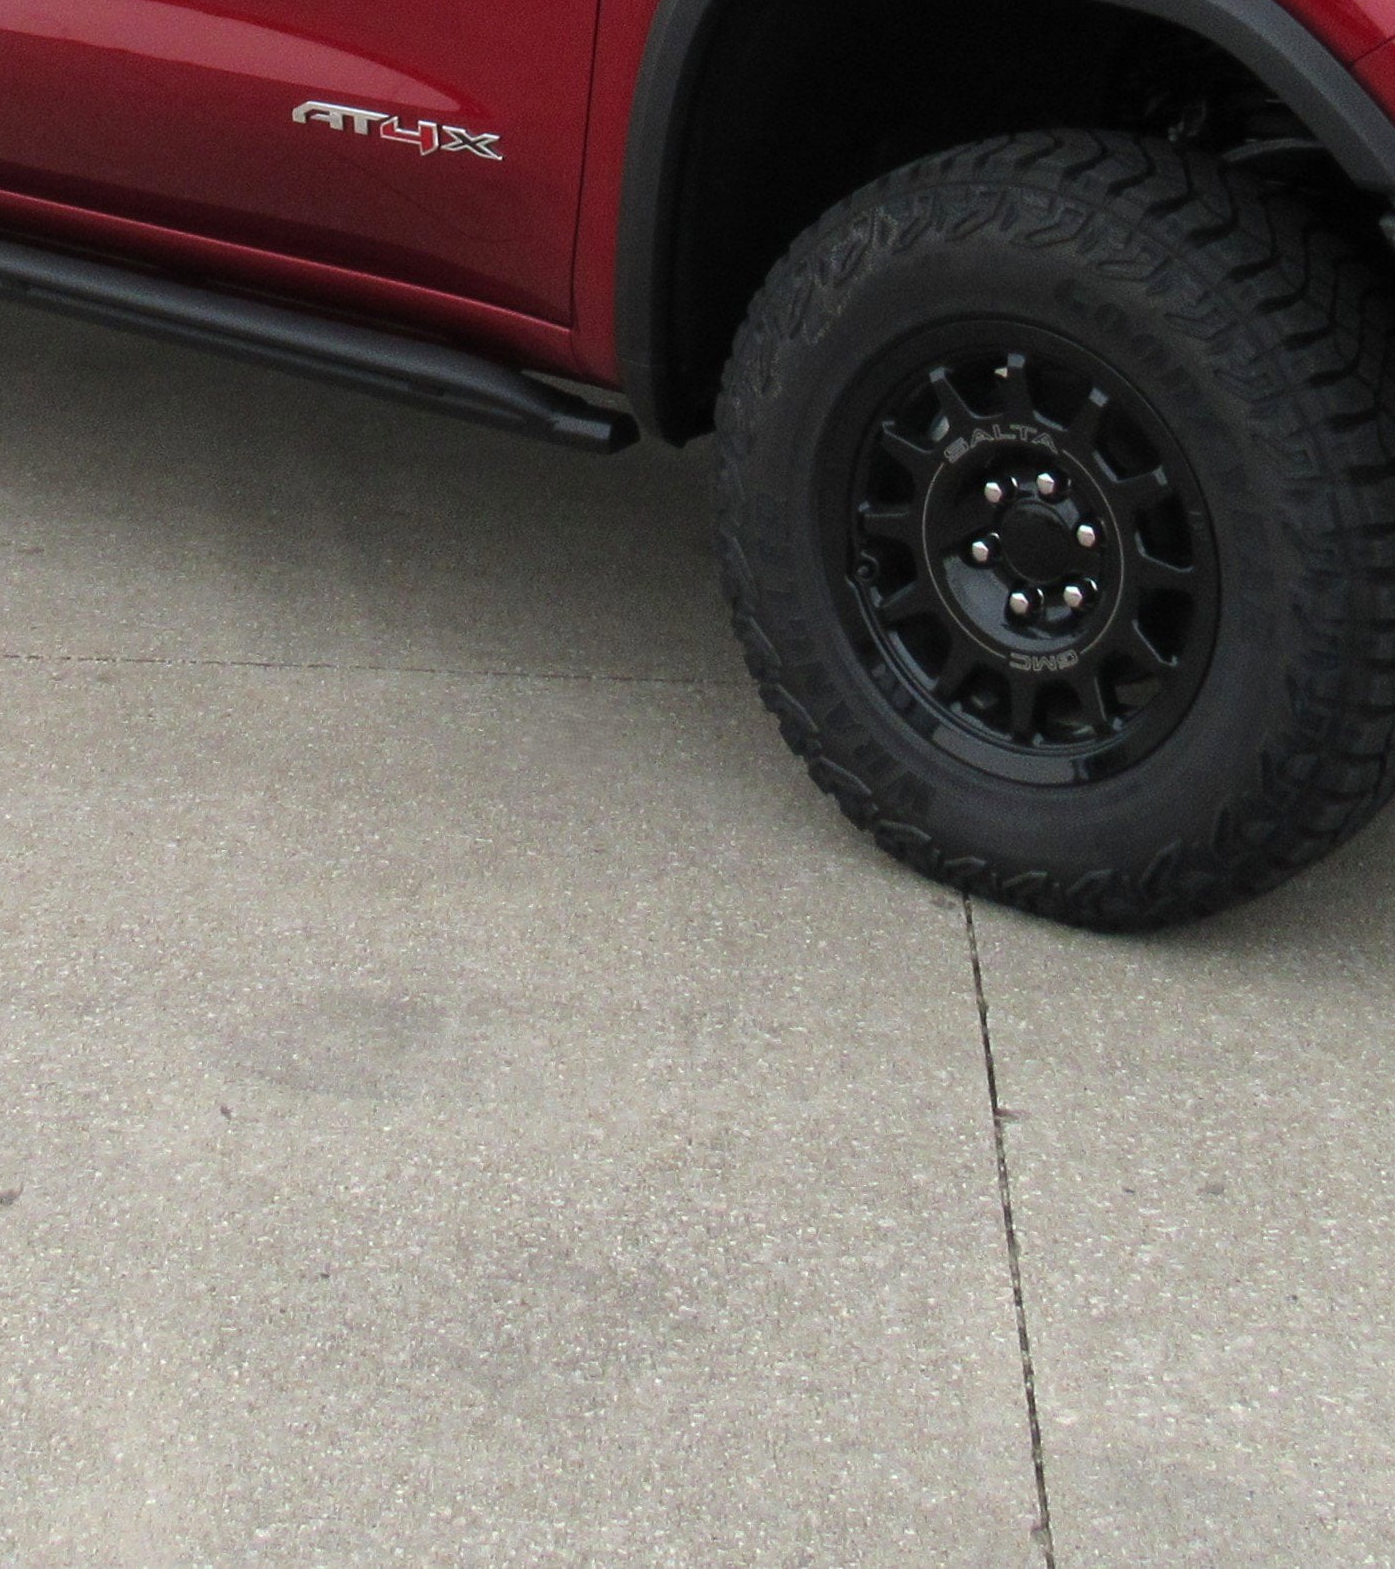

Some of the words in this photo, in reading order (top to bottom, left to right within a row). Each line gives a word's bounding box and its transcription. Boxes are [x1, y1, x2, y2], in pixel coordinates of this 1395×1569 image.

[292, 100, 504, 161] AT4X
[943, 423, 1059, 464] SALTA
[1008, 646, 1080, 672] GMC
